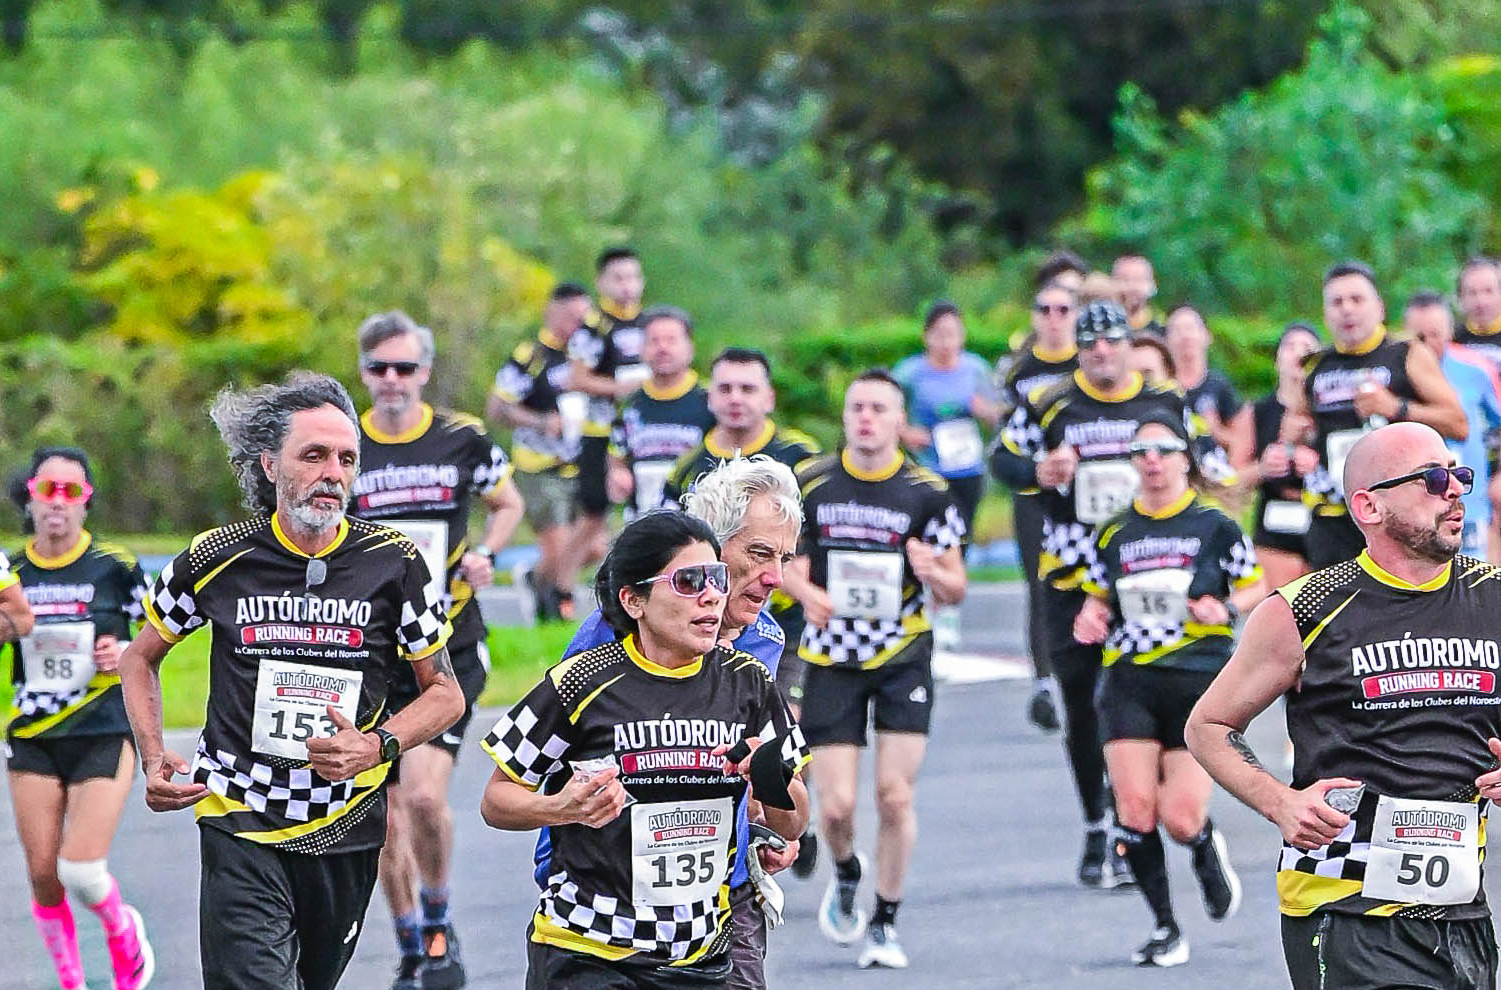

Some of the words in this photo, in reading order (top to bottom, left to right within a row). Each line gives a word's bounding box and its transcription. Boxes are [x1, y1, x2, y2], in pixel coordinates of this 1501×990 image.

[235, 590, 372, 627] AUTÓDROMO
[848, 587, 878, 609] 53
[255, 626, 312, 642] RUNNING
[316, 628, 351, 645] RACE
[242, 646, 269, 655] Carrera
[271, 647, 282, 656] de
[283, 647, 295, 656] los
[296, 648, 322, 657] Clubes
[324, 648, 337, 658] del
[1351, 631, 1500, 676] AUTÓDROMO
[43, 658, 73, 679] 88
[273, 669, 347, 694] AUTÓDROMO
[1378, 672, 1439, 695] RUNNING
[1443, 672, 1482, 690] RACE
[1352, 701, 1362, 710] La
[1364, 700, 1397, 710] Carrera
[1399, 699, 1410, 709] de
[1411, 698, 1423, 707] los
[1425, 697, 1452, 707] Clubes
[1453, 696, 1467, 705] del
[1469, 696, 1501, 705] Noroest
[636, 751, 696, 771] RUNNING
[700, 752, 727, 769] RAC
[622, 775, 652, 785] Carrera
[654, 775, 664, 784] de
[666, 775, 677, 784] los
[679, 775, 706, 784] Clubes
[707, 775, 720, 784] del
[649, 807, 722, 831] AUTÓDROMO
[1392, 807, 1466, 831] AUTÓDROMO
[651, 850, 715, 888] 135
[1397, 853, 1450, 887] 50
